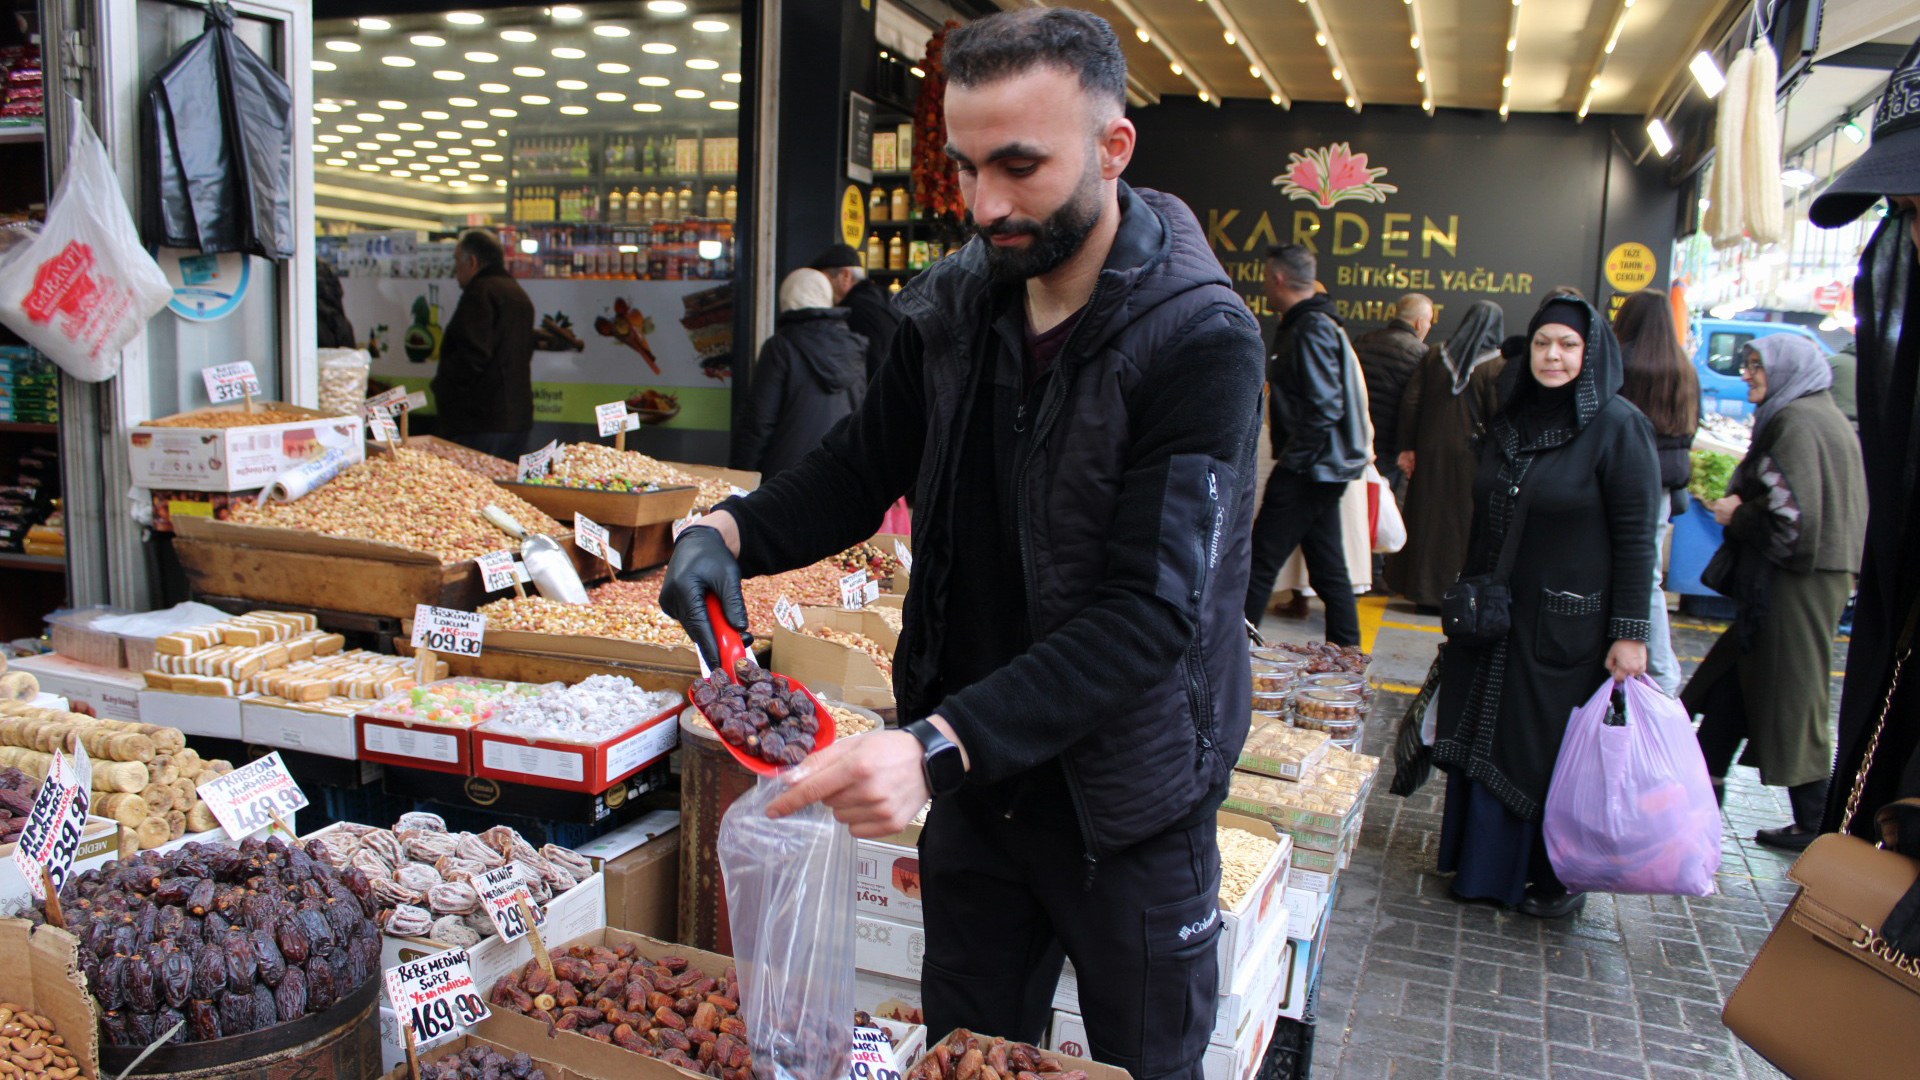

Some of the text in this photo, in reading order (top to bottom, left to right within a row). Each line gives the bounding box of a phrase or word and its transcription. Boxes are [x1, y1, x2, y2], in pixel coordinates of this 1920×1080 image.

[1208, 209, 1459, 258] KARDEN
[1623, 249, 1640, 258] TAZE
[1337, 263, 1435, 290] BİTKİSEL
[1440, 267, 1533, 294] YAĞLAR
[1336, 299, 1444, 324] BAHAT
[1210, 513, 1224, 569] Columbia
[420, 629, 481, 655] 109.90
[210, 756, 277, 792] TRABZON
[20, 775, 58, 857] AMBER
[30, 783, 65, 861] HURMASI
[233, 787, 307, 830] 469.90
[37, 829, 55, 865] YENİ
[482, 886, 506, 900] MEDİNE
[486, 865, 513, 886] MUNİF
[398, 950, 467, 983] BEBE MEDİNE
[1871, 937, 1920, 978] GUES
[419, 970, 452, 991] SÜPER
[411, 993, 487, 1042] 16990
